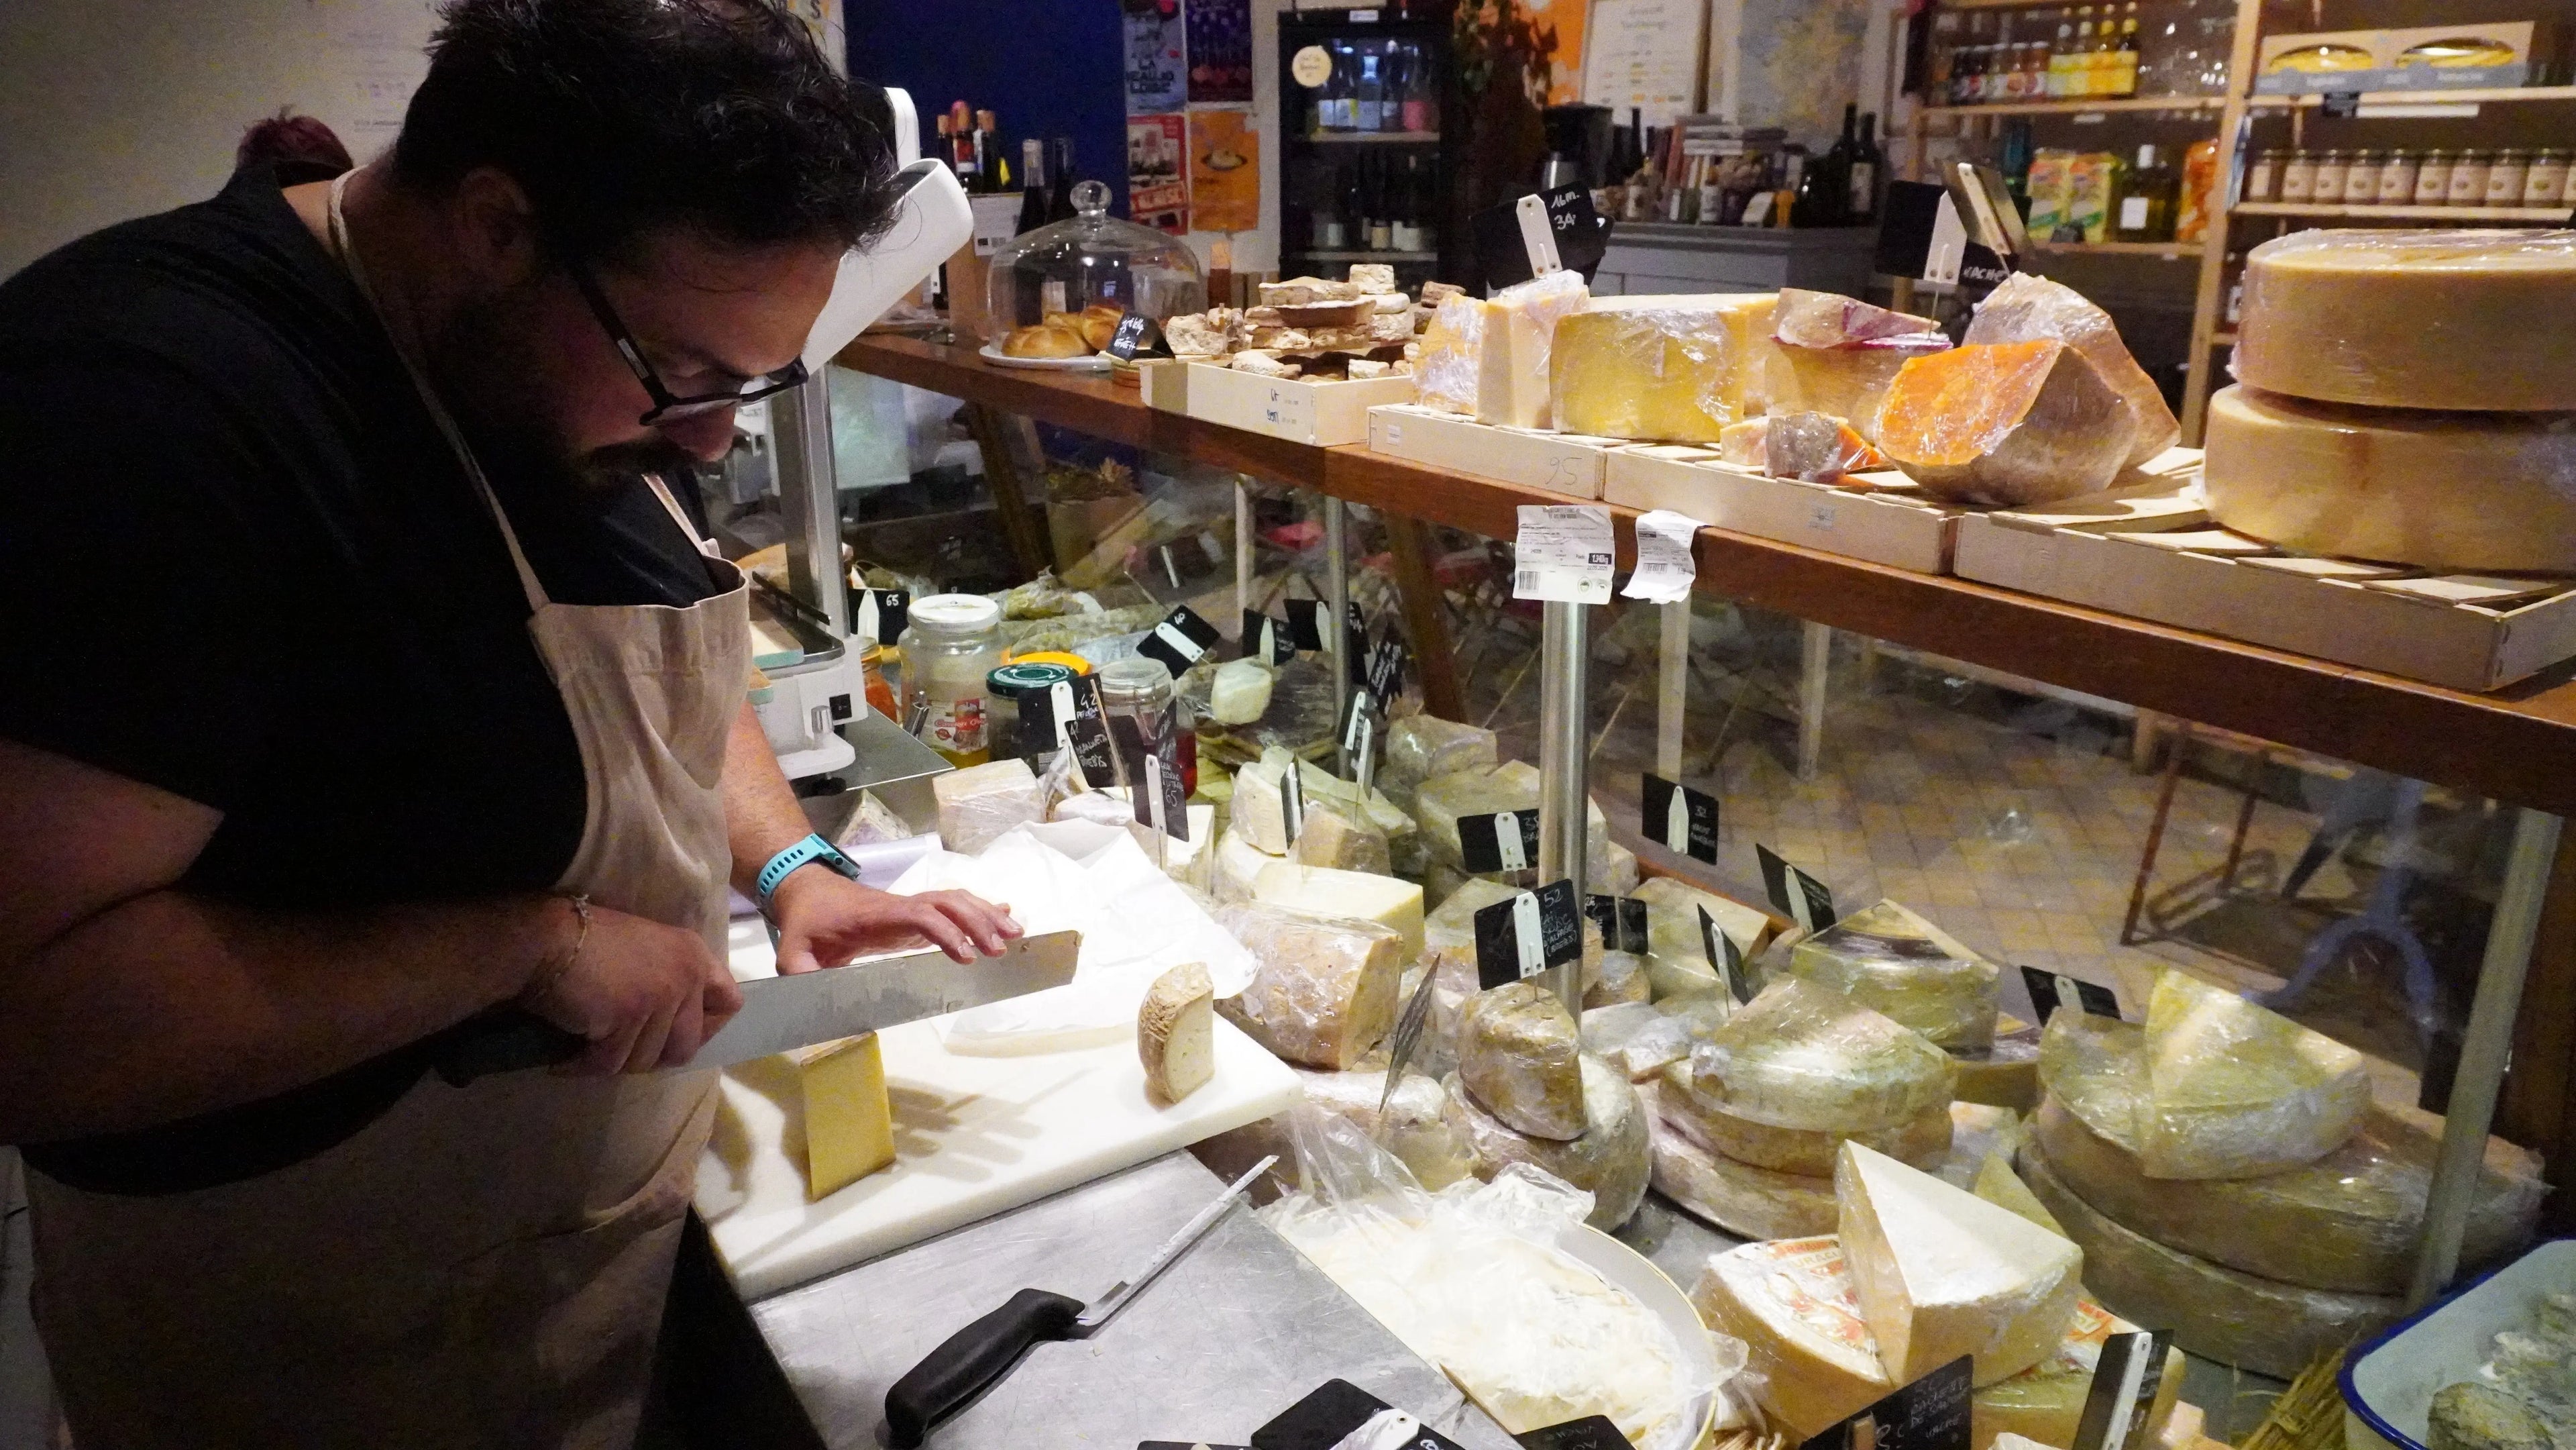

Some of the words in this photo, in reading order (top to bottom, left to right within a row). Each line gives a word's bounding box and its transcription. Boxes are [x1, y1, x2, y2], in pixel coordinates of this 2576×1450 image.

[886, 594, 899, 607] 65
[1165, 786, 1178, 807] 65
[1544, 888, 1564, 908] 52
